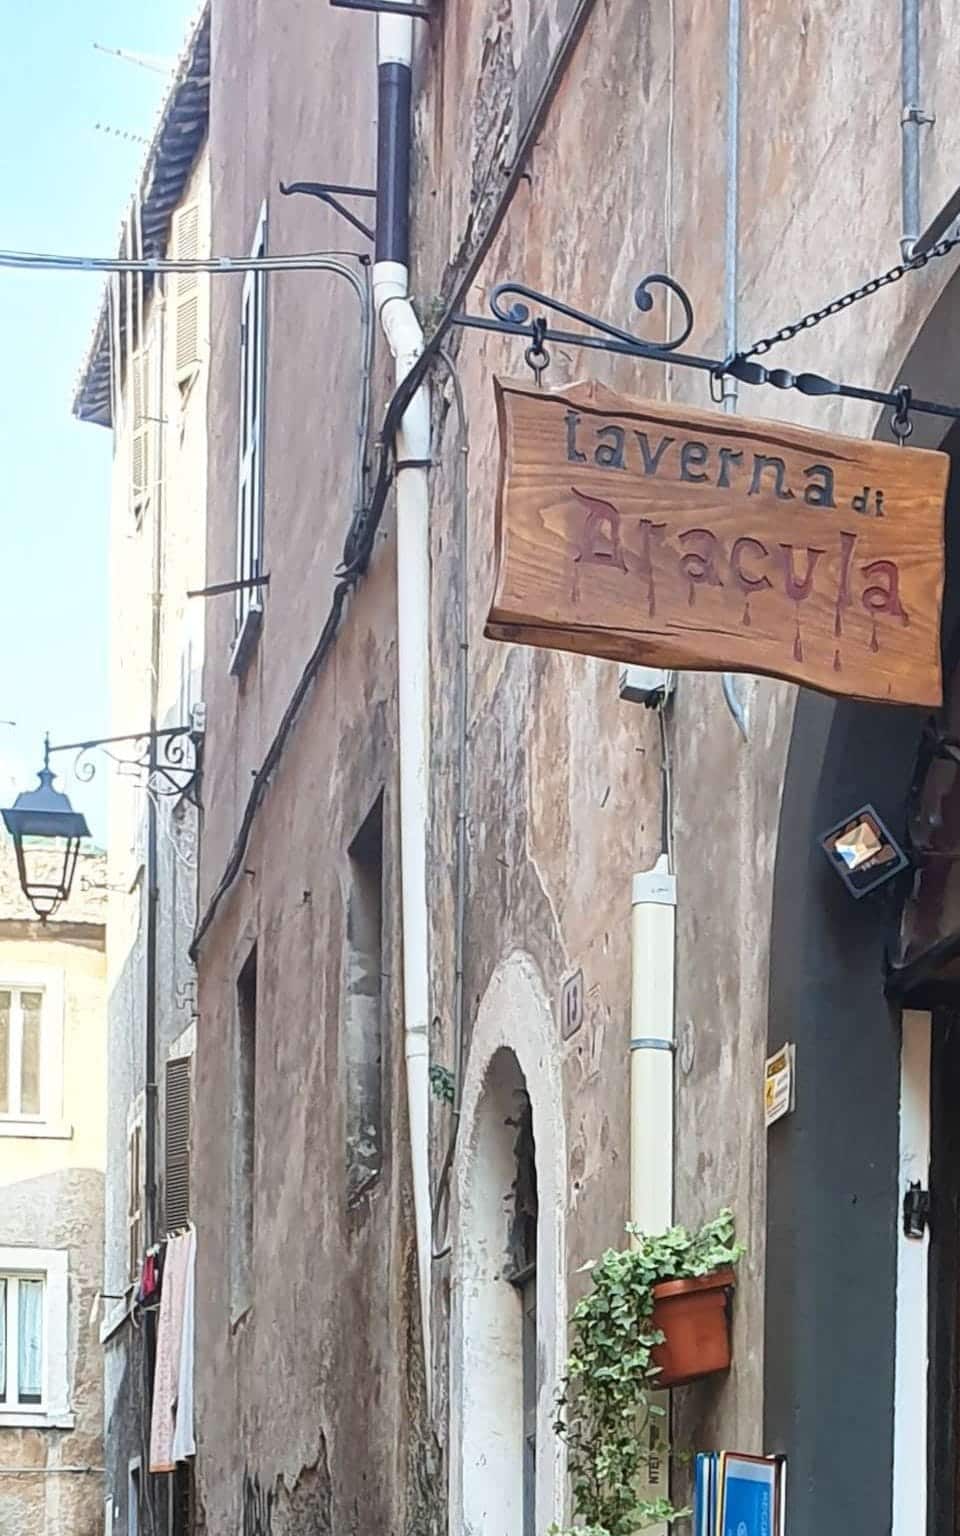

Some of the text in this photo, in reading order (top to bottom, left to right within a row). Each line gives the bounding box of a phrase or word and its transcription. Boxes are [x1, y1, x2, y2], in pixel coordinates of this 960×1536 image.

[565, 408, 885, 517] taverna di
[571, 487, 910, 630] Dracula
